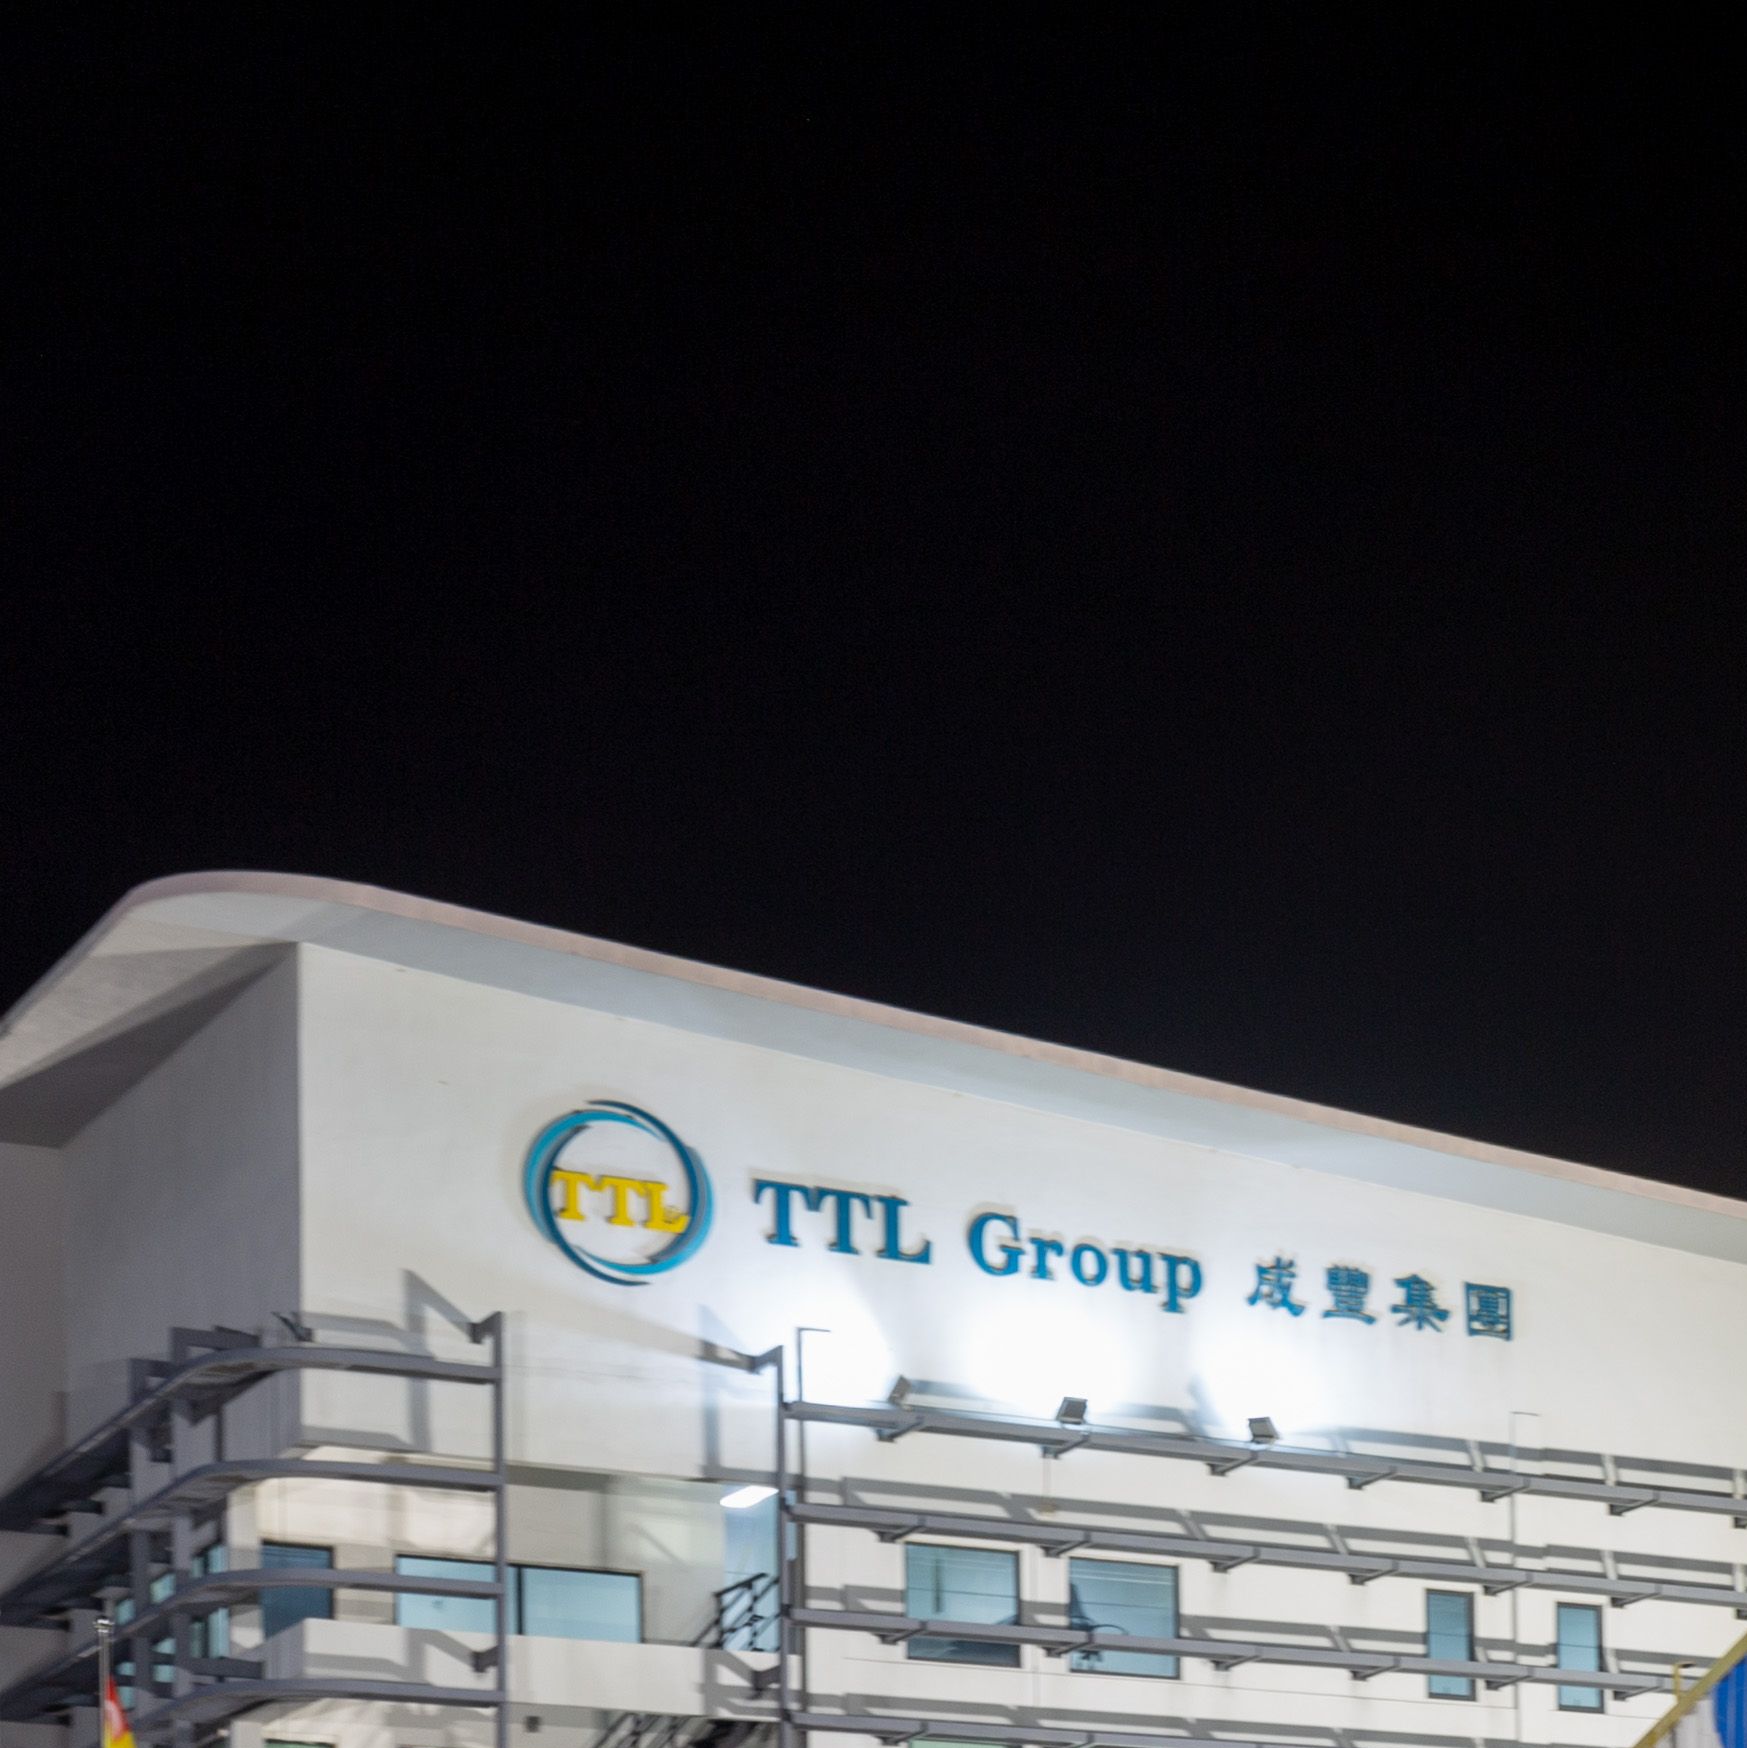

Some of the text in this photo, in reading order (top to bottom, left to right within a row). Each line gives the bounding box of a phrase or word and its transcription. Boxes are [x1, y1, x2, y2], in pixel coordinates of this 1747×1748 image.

[551, 1170, 691, 1233] TTL
[752, 1178, 933, 1265] TTL
[967, 1212, 1203, 1314] Group
